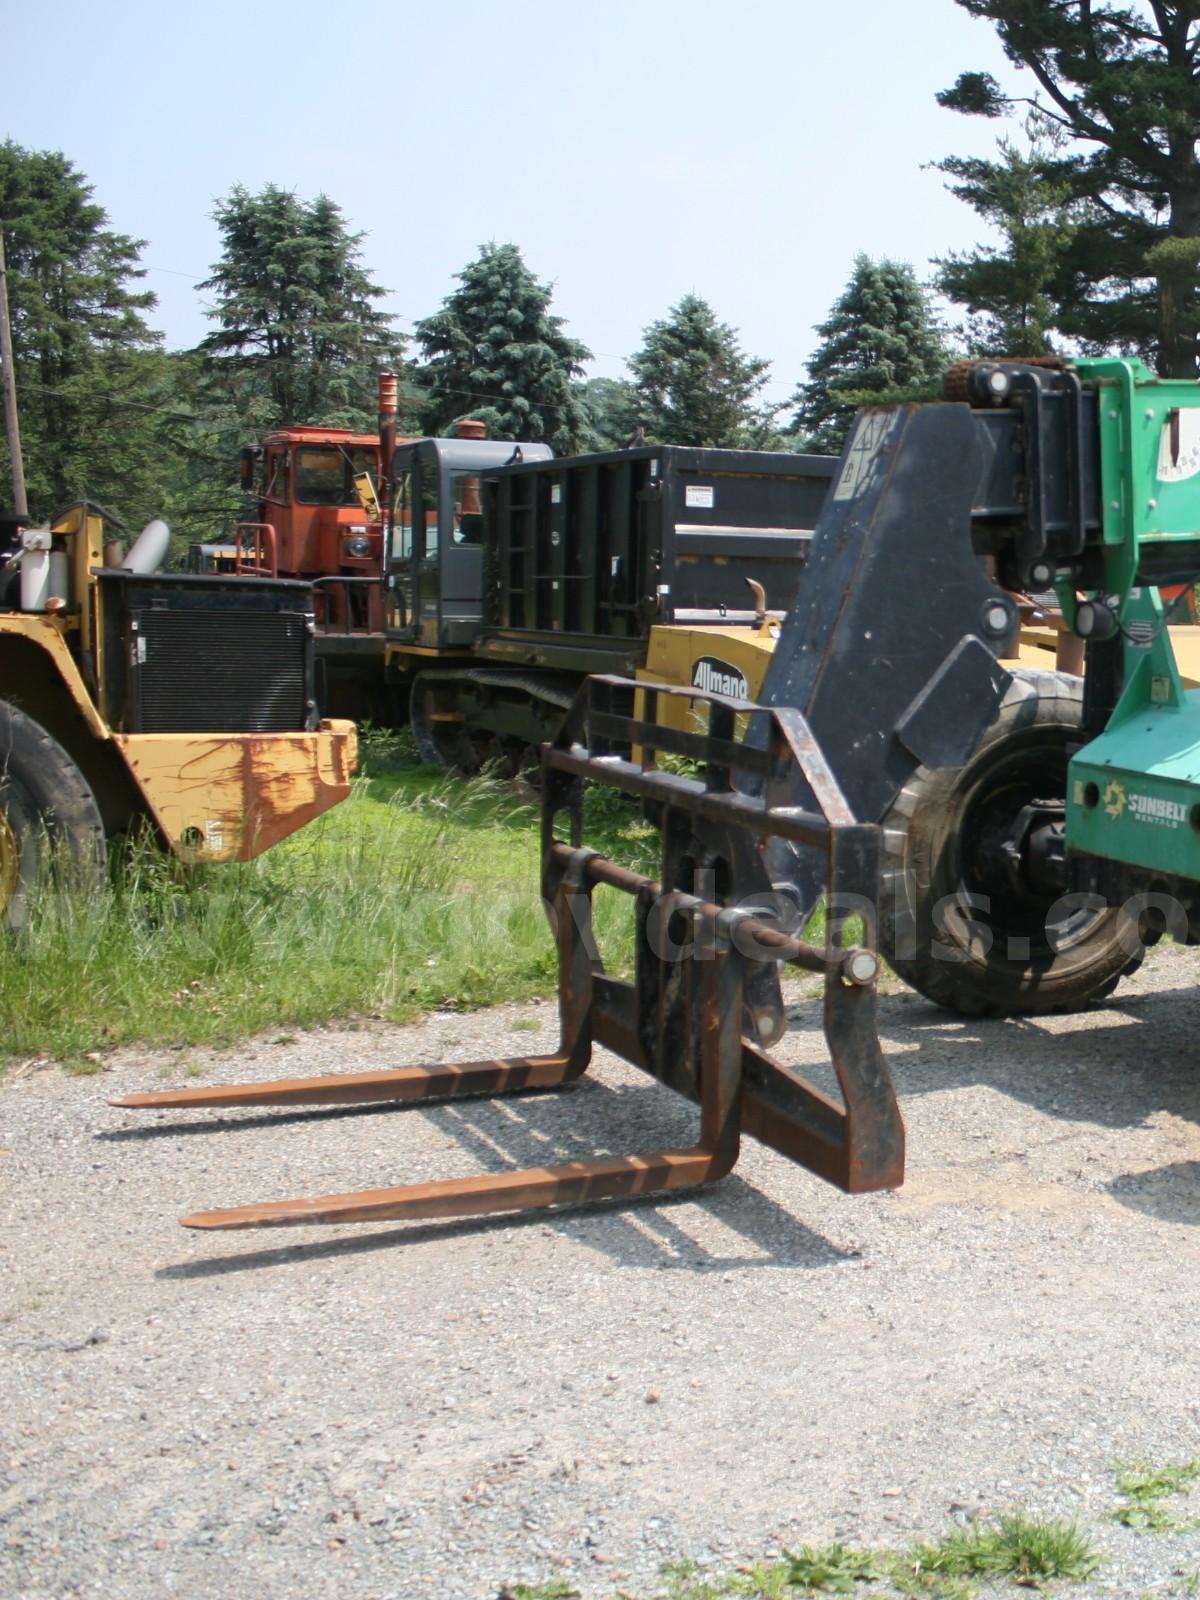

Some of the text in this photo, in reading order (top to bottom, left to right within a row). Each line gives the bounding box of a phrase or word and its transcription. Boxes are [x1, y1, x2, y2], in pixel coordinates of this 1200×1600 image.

[693, 661, 748, 700] Allmand
[1128, 793, 1188, 822] SUNBELT
[1135, 813, 1179, 829] RENTALS
